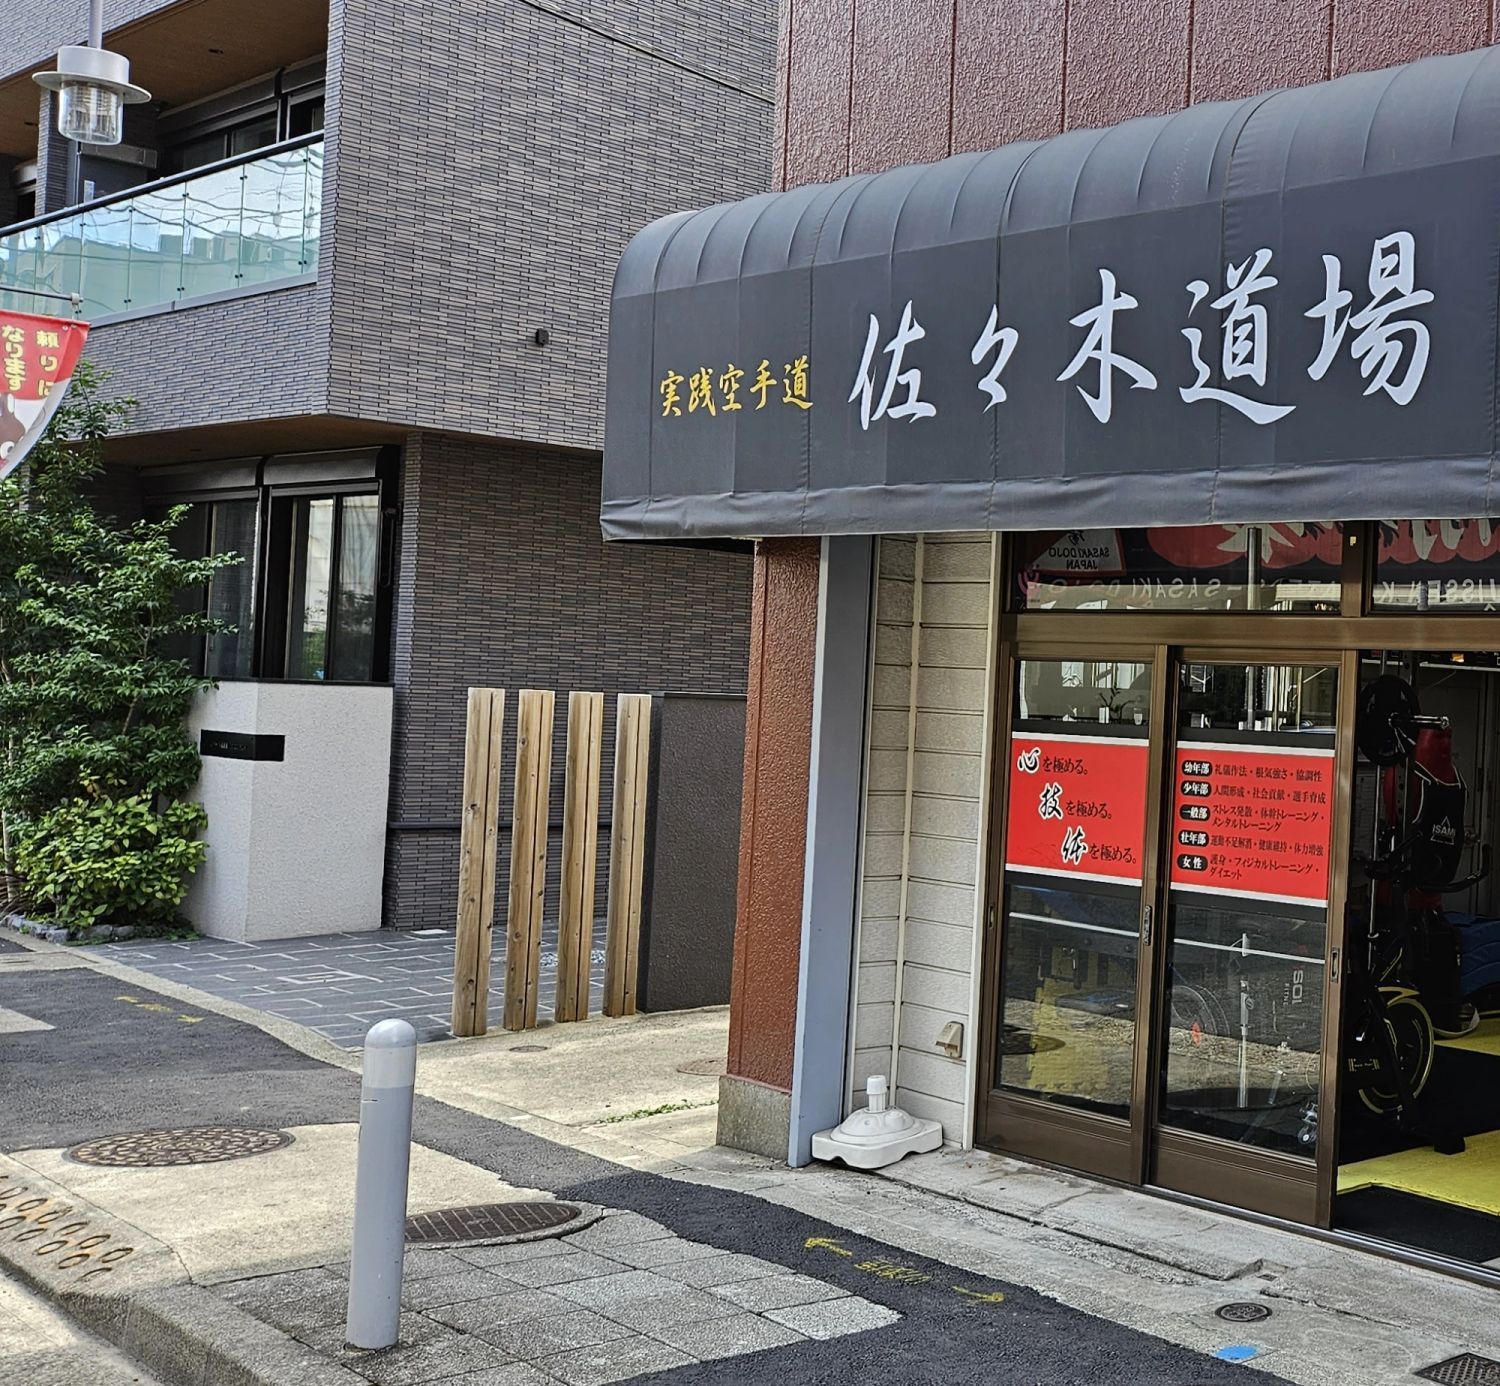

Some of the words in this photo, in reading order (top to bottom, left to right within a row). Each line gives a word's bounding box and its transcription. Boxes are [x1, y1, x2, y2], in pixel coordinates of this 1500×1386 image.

[847, 230, 1436, 431] 佐々木道場
[1, 324, 27, 391] なります
[659, 355, 815, 416] 実践空手道
[1017, 747, 1088, 775] 心を極める。
[1183, 762, 1210, 775] 幼年部
[1183, 783, 1210, 796] 少年部
[1038, 781, 1112, 820] 技を極める。
[1181, 807, 1208, 820] 一般部
[1212, 817, 1282, 832] メンタルトレーニング
[1182, 856, 1204, 869] 女性
[1209, 867, 1243, 880] ダイエット
